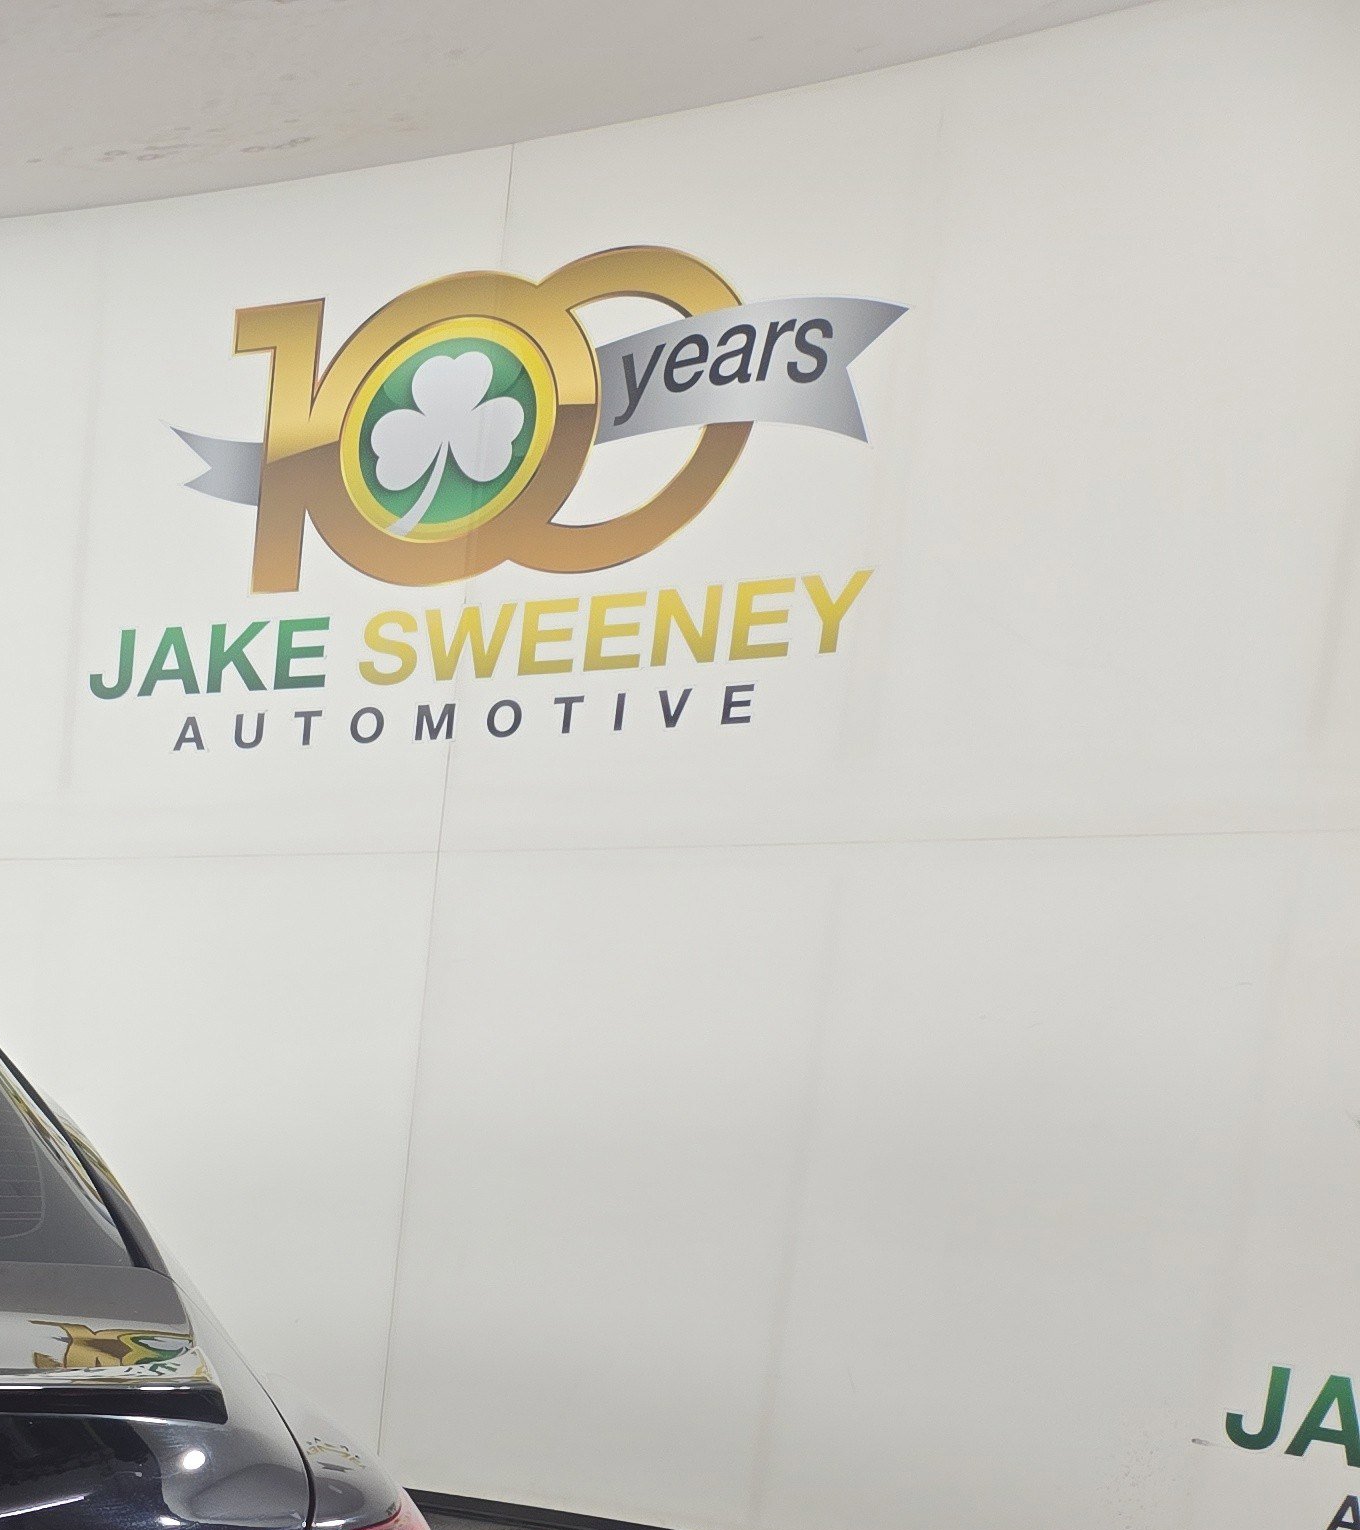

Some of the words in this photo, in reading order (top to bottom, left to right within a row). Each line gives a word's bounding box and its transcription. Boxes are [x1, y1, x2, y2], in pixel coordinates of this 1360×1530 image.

[233, 245, 754, 595] 100
[614, 315, 834, 427] years
[89, 616, 331, 701] JAKE
[358, 569, 874, 686] SWEENEY
[172, 682, 756, 752] AUTOMOTIVE
